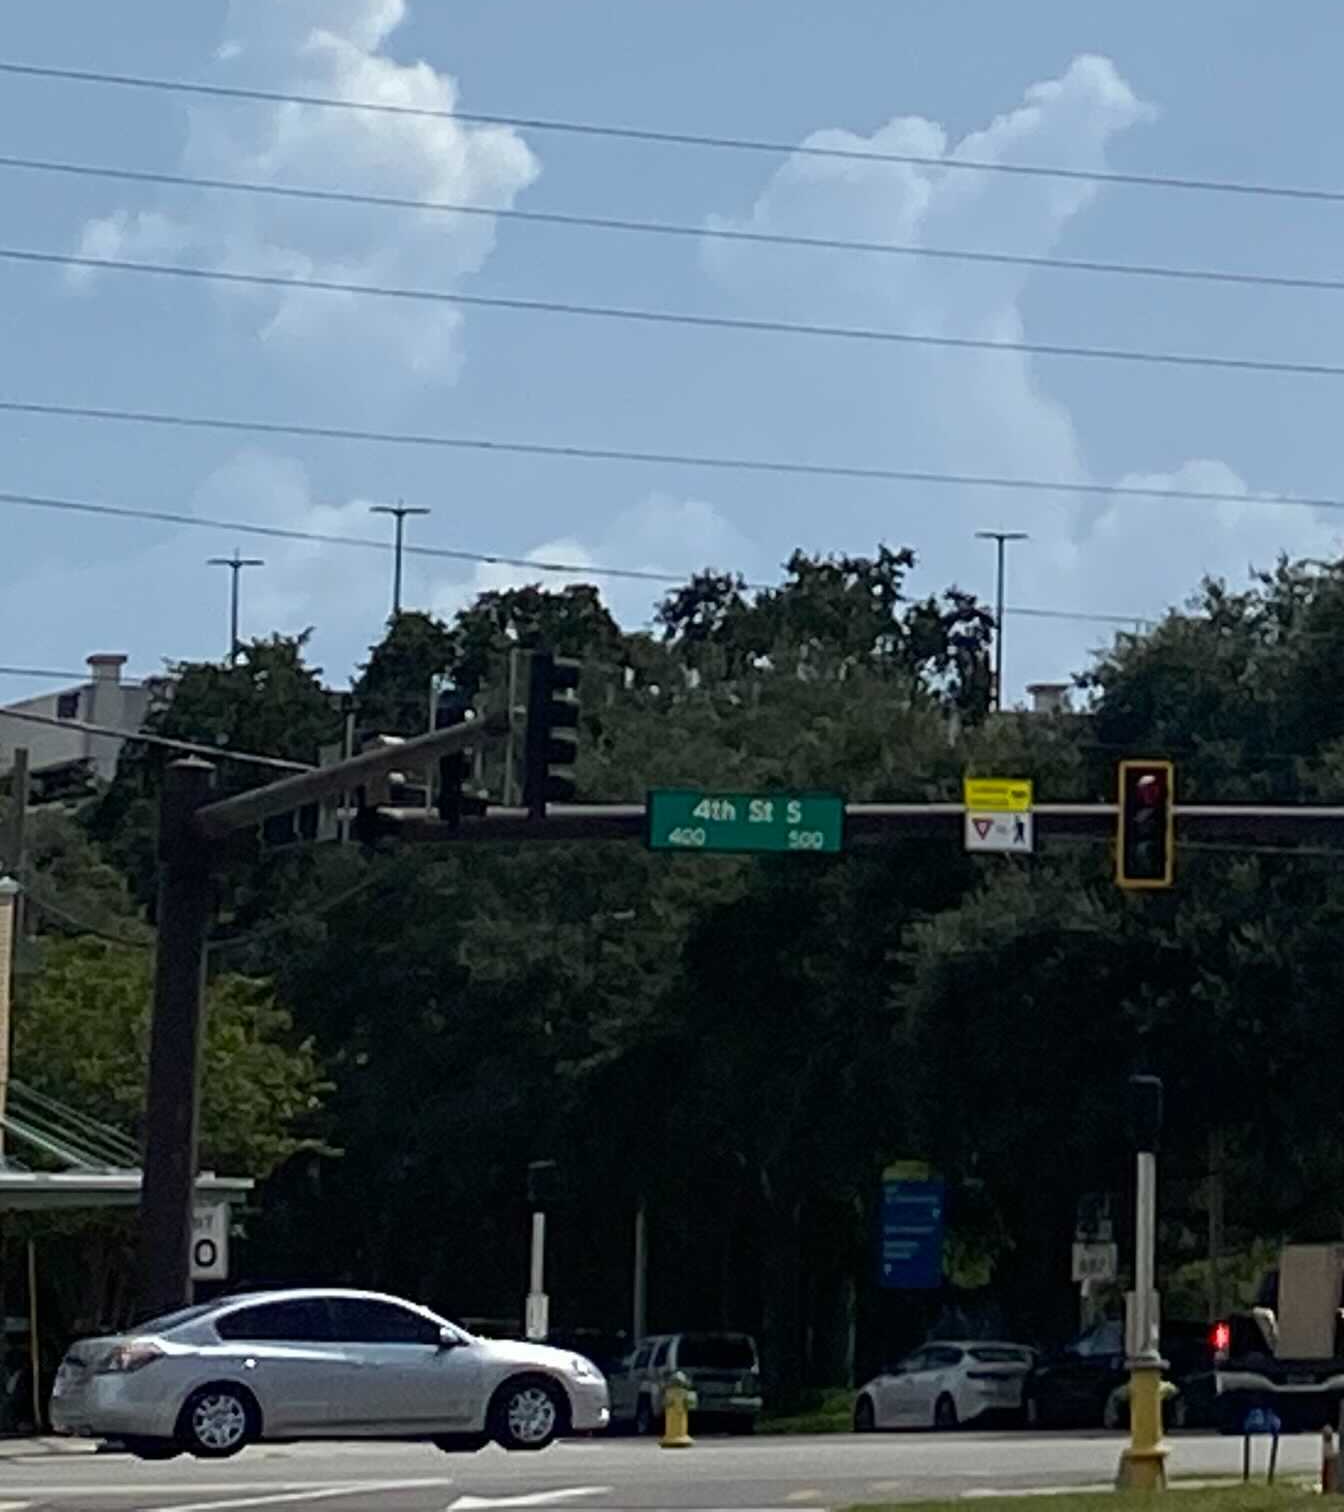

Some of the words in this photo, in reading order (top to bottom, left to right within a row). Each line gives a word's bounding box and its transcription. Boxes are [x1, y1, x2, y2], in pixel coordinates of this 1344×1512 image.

[692, 799, 737, 821] 4th
[748, 799, 775, 823] St
[785, 800, 803, 824] S
